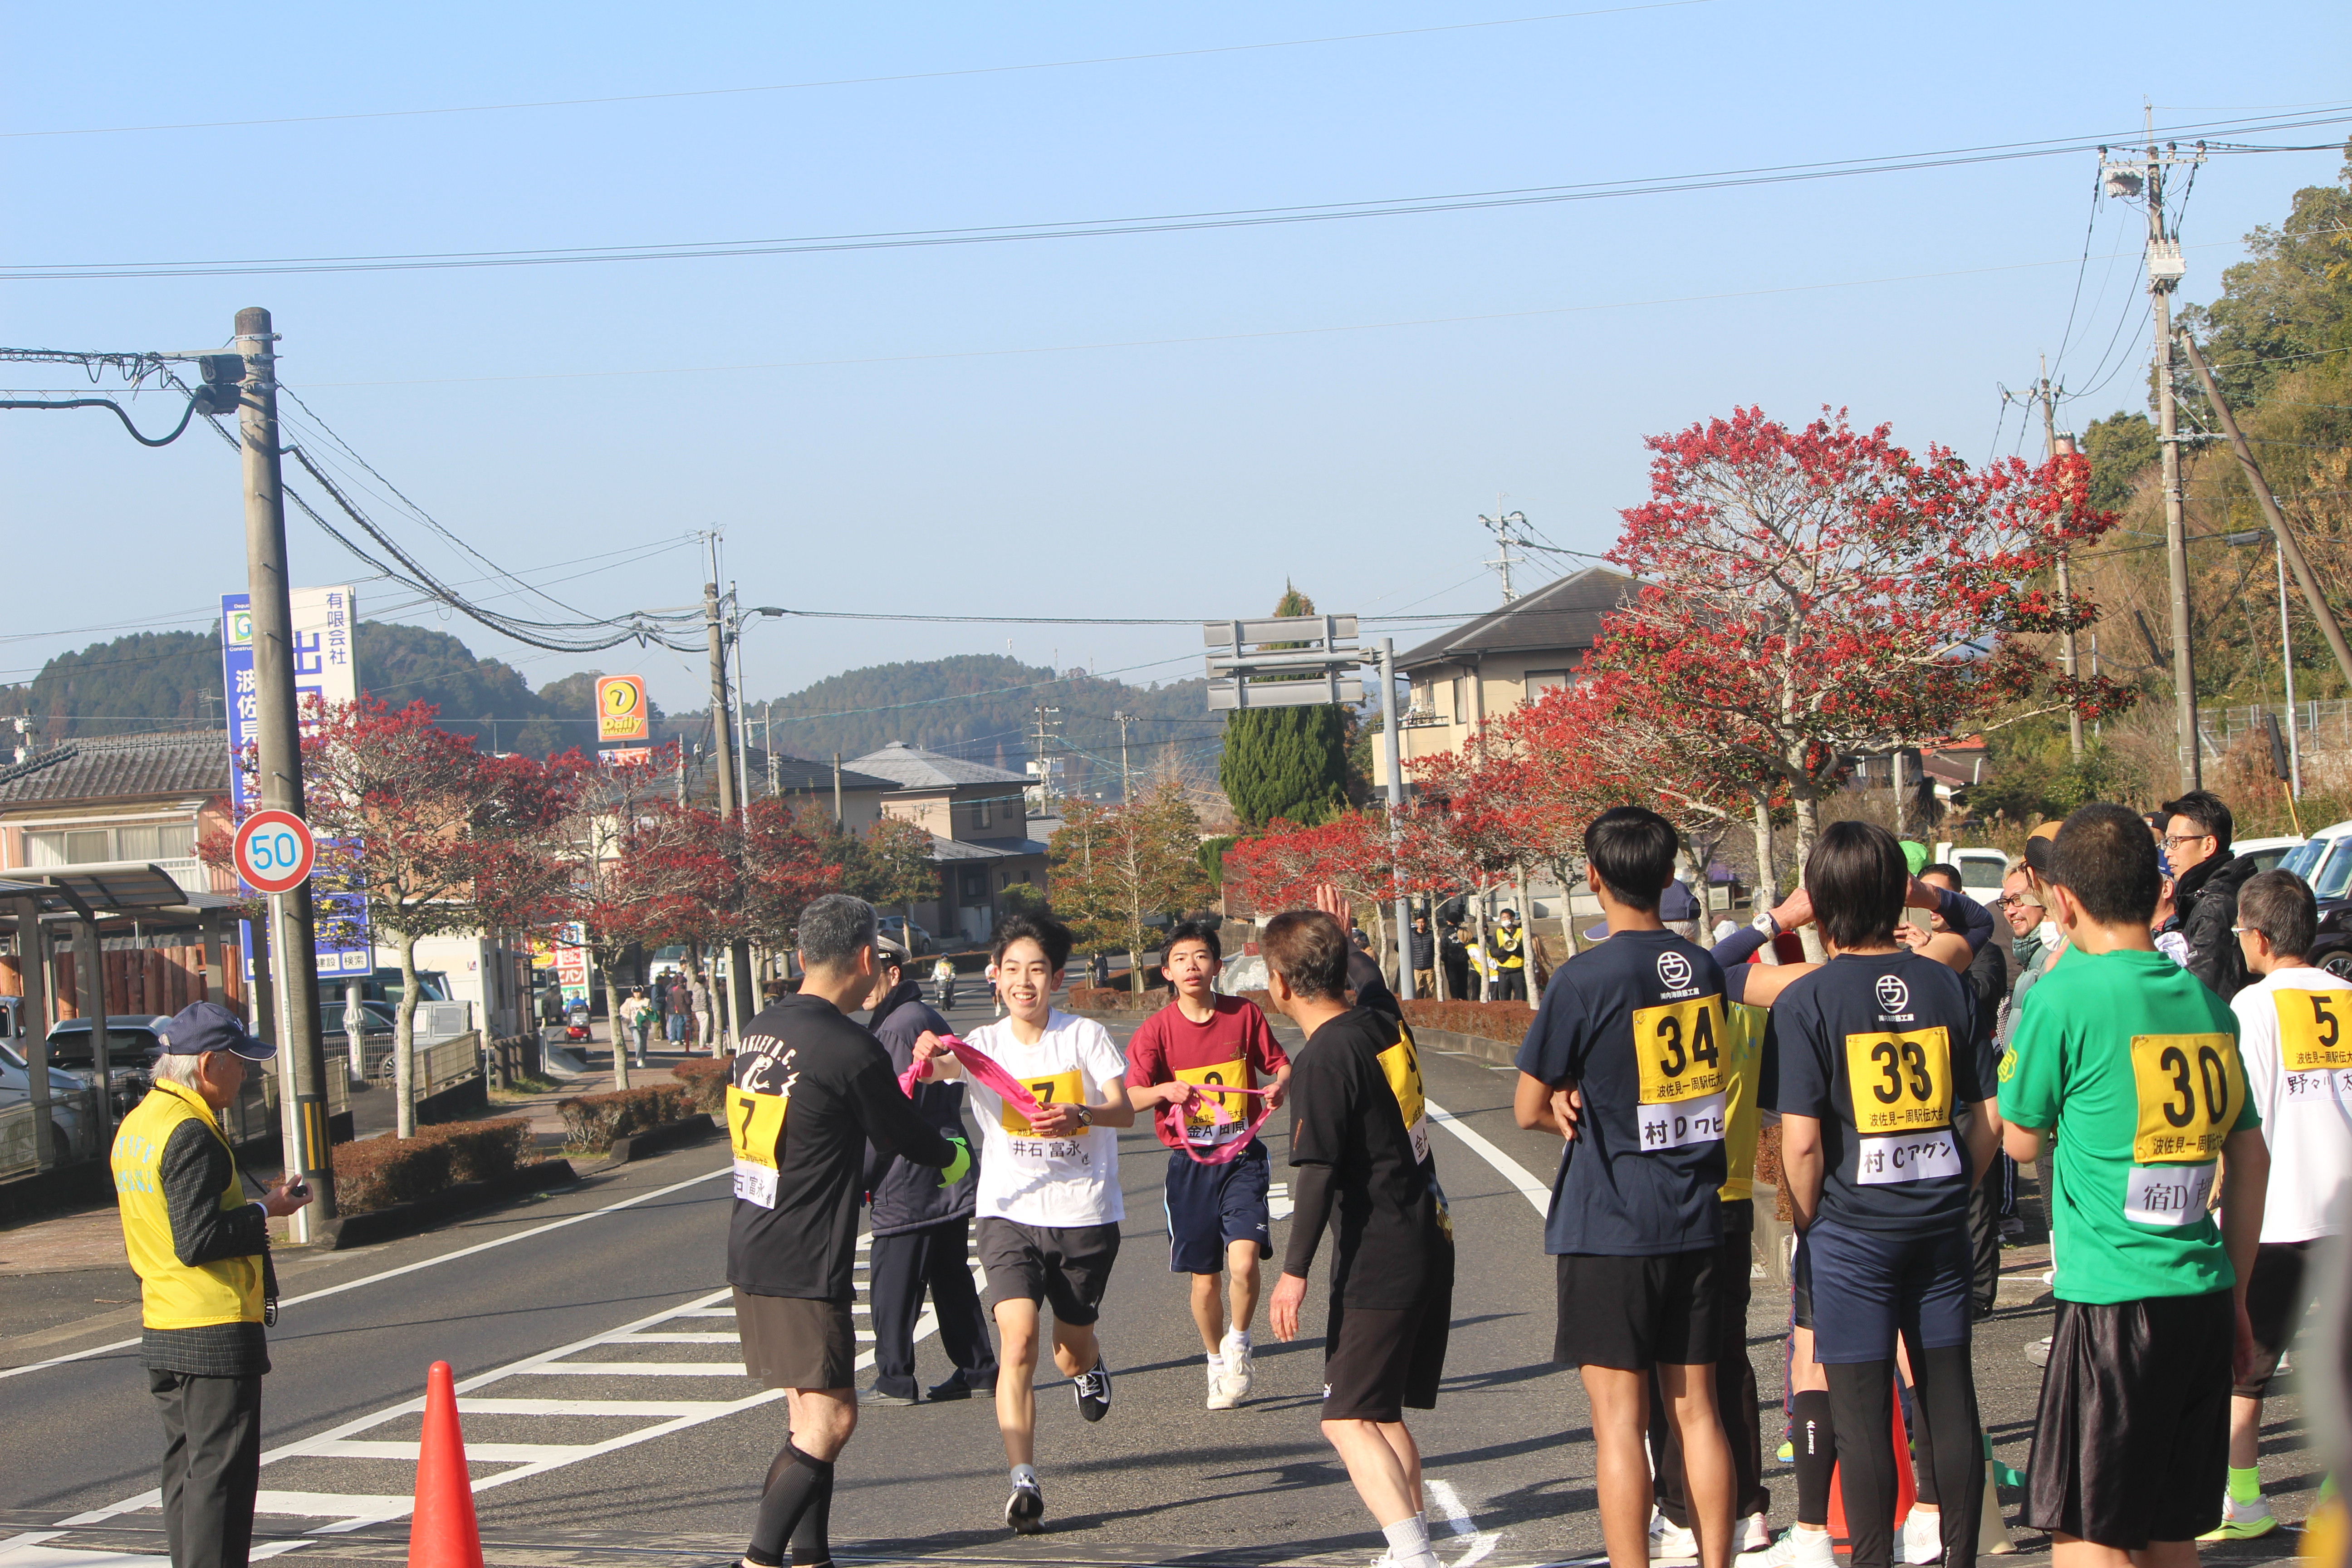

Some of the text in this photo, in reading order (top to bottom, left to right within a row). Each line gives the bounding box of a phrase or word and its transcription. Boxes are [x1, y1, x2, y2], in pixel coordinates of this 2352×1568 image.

[326, 593, 347, 665] 有限会社
[602, 716, 644, 733] Daily
[251, 833, 296, 870] 50
[344, 956, 364, 966] 検索
[563, 950, 580, 963] たばこ
[2309, 995, 2339, 1047] 5
[735, 1034, 776, 1058] OAKLEY
[1657, 1006, 1719, 1078] 34
[1657, 1072, 1723, 1098] 波佐見一周駅伝大
[1871, 1041, 1933, 1104] 33
[2288, 1073, 2334, 1096] 野々川
[1032, 1081, 1054, 1110] 7
[1204, 1072, 1225, 1106] 9
[2161, 1045, 2228, 1128] 30
[739, 1097, 756, 1150] 7
[1869, 1106, 1944, 1127] 波佐見一周駅伝大会
[1013, 1140, 1082, 1157] 井石 富永
[749, 1176, 765, 1198] 富永
